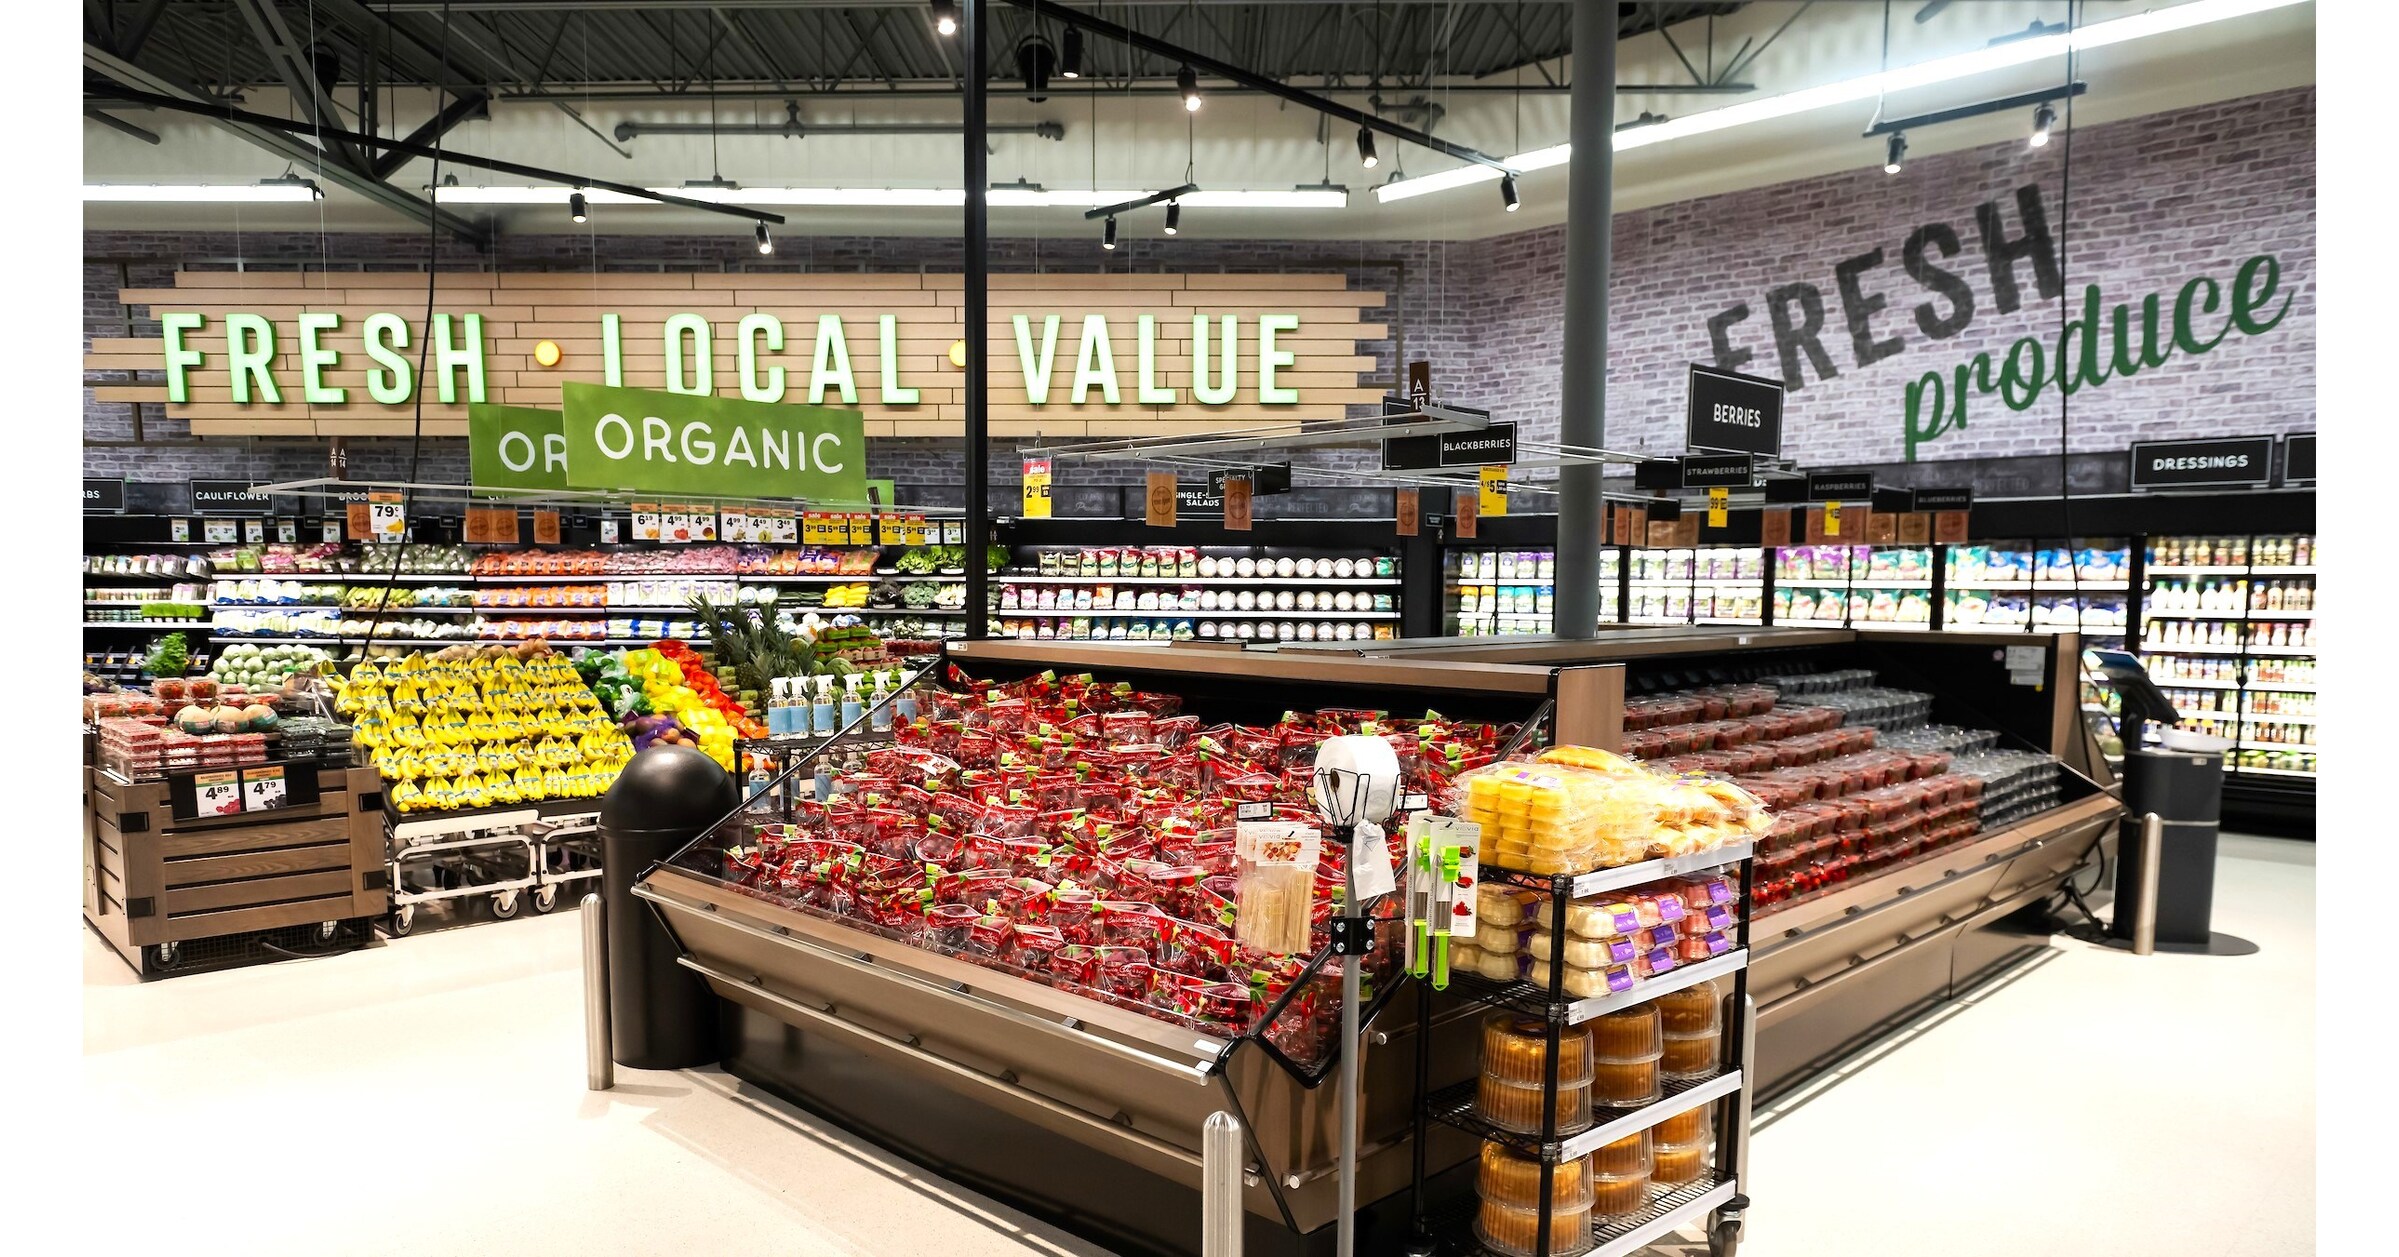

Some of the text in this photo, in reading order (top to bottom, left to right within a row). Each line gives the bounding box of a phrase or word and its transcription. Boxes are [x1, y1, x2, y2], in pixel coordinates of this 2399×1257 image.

[1706, 183, 2063, 392] FRESH
[161, 312, 488, 405] FRESH
[1012, 313, 1300, 406] VALUE
[1904, 254, 2295, 461] produce
[1414, 379, 1424, 392] A
[1713, 402, 1762, 428] BERRIES
[594, 413, 845, 474] ORGANIC
[1443, 438, 1511, 451] BLACKBERRIES
[2152, 454, 2249, 472] DRESSINGS
[1686, 466, 1748, 476] STRAWBERRIES
[195, 491, 270, 501] CAULIFLOWER
[1186, 499, 1220, 507] SALADS
[1106, 914, 1137, 925] California
